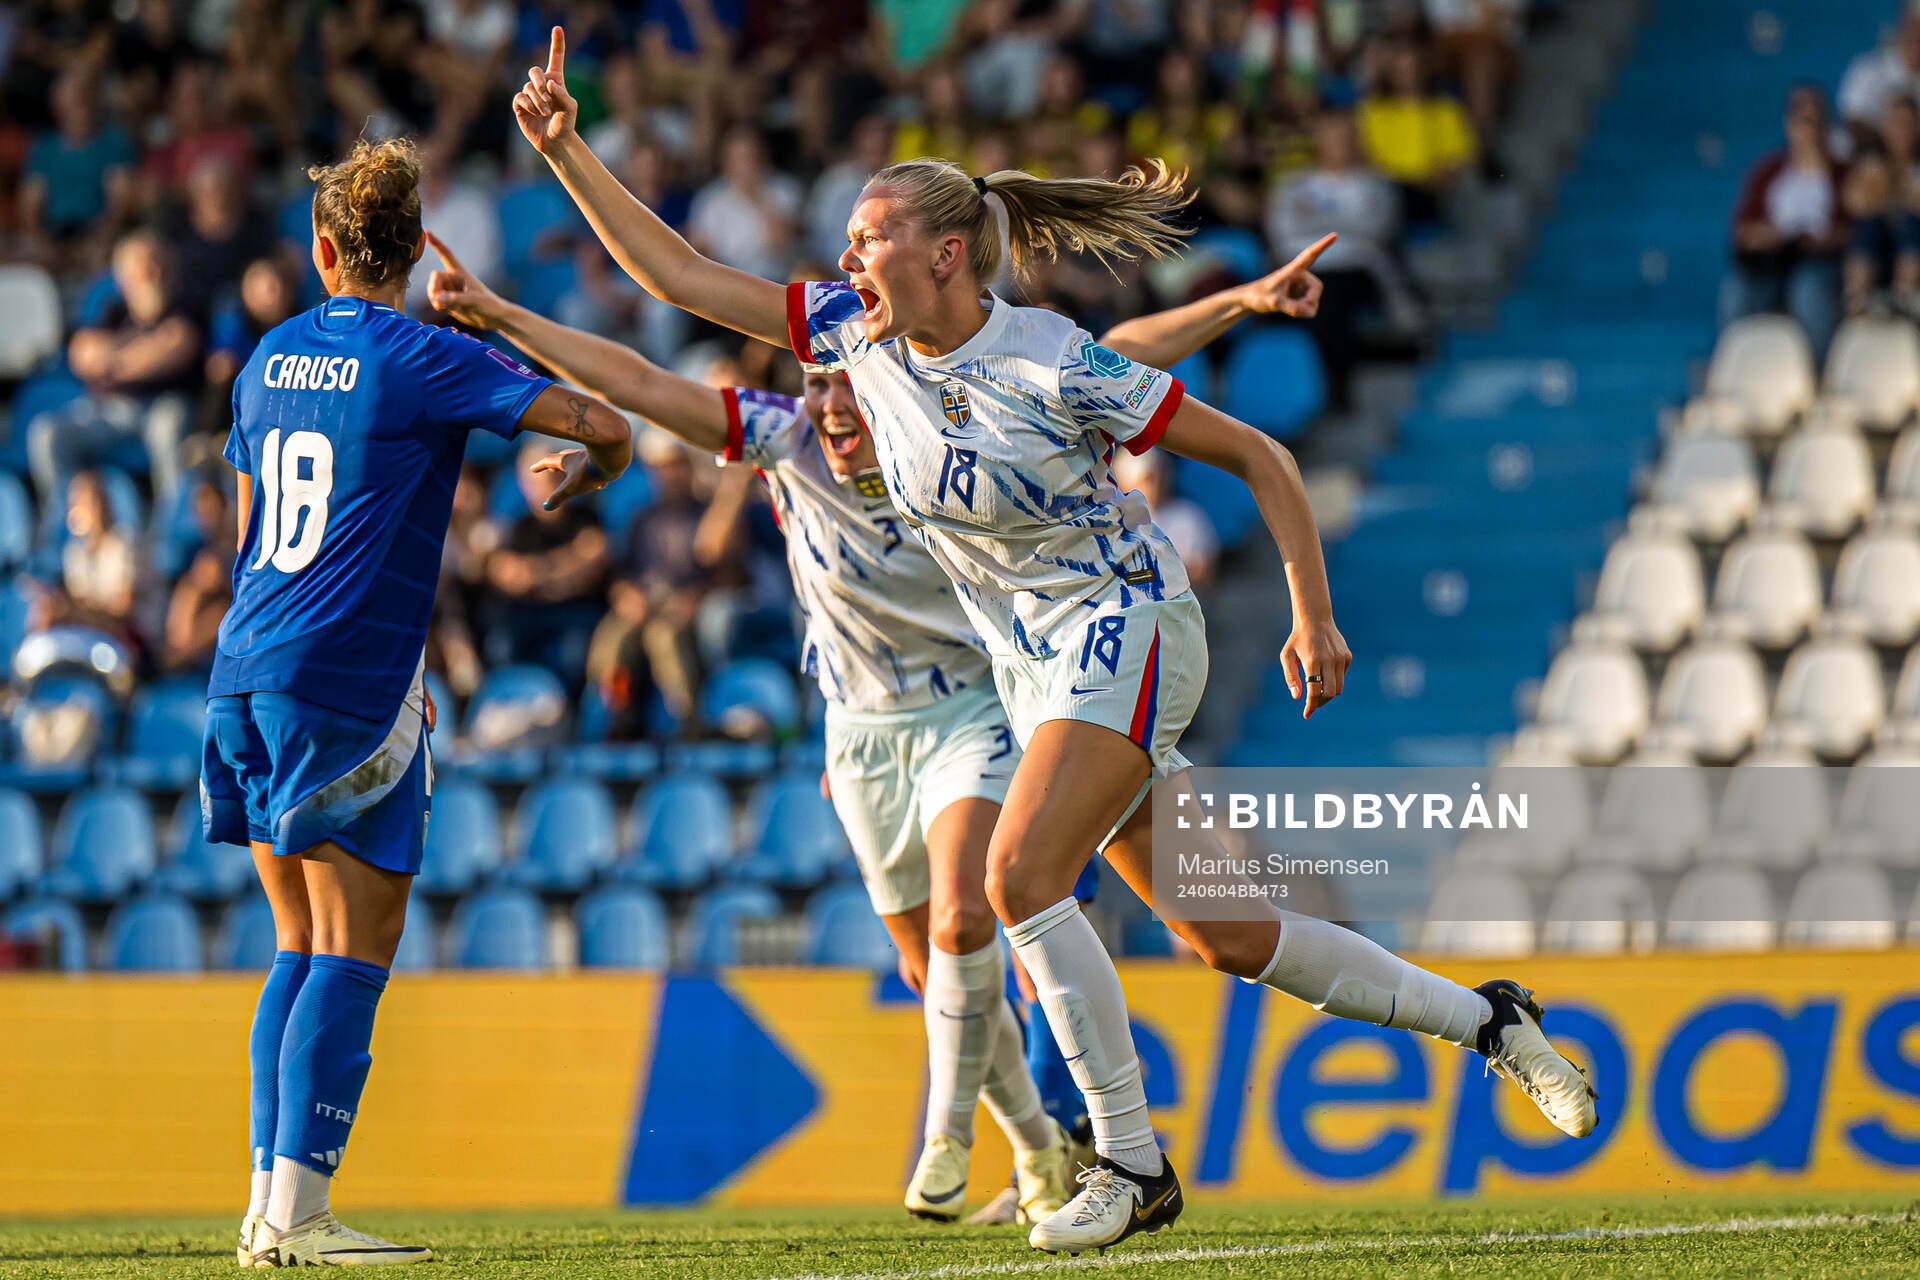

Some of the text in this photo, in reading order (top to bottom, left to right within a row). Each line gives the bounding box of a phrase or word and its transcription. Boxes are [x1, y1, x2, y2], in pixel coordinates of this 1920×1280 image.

[263, 353, 360, 392] CARUSO
[251, 427, 334, 574] 18
[936, 443, 978, 513] 18
[1079, 615, 1126, 677] 18
[873, 970, 1920, 1197] lepas
